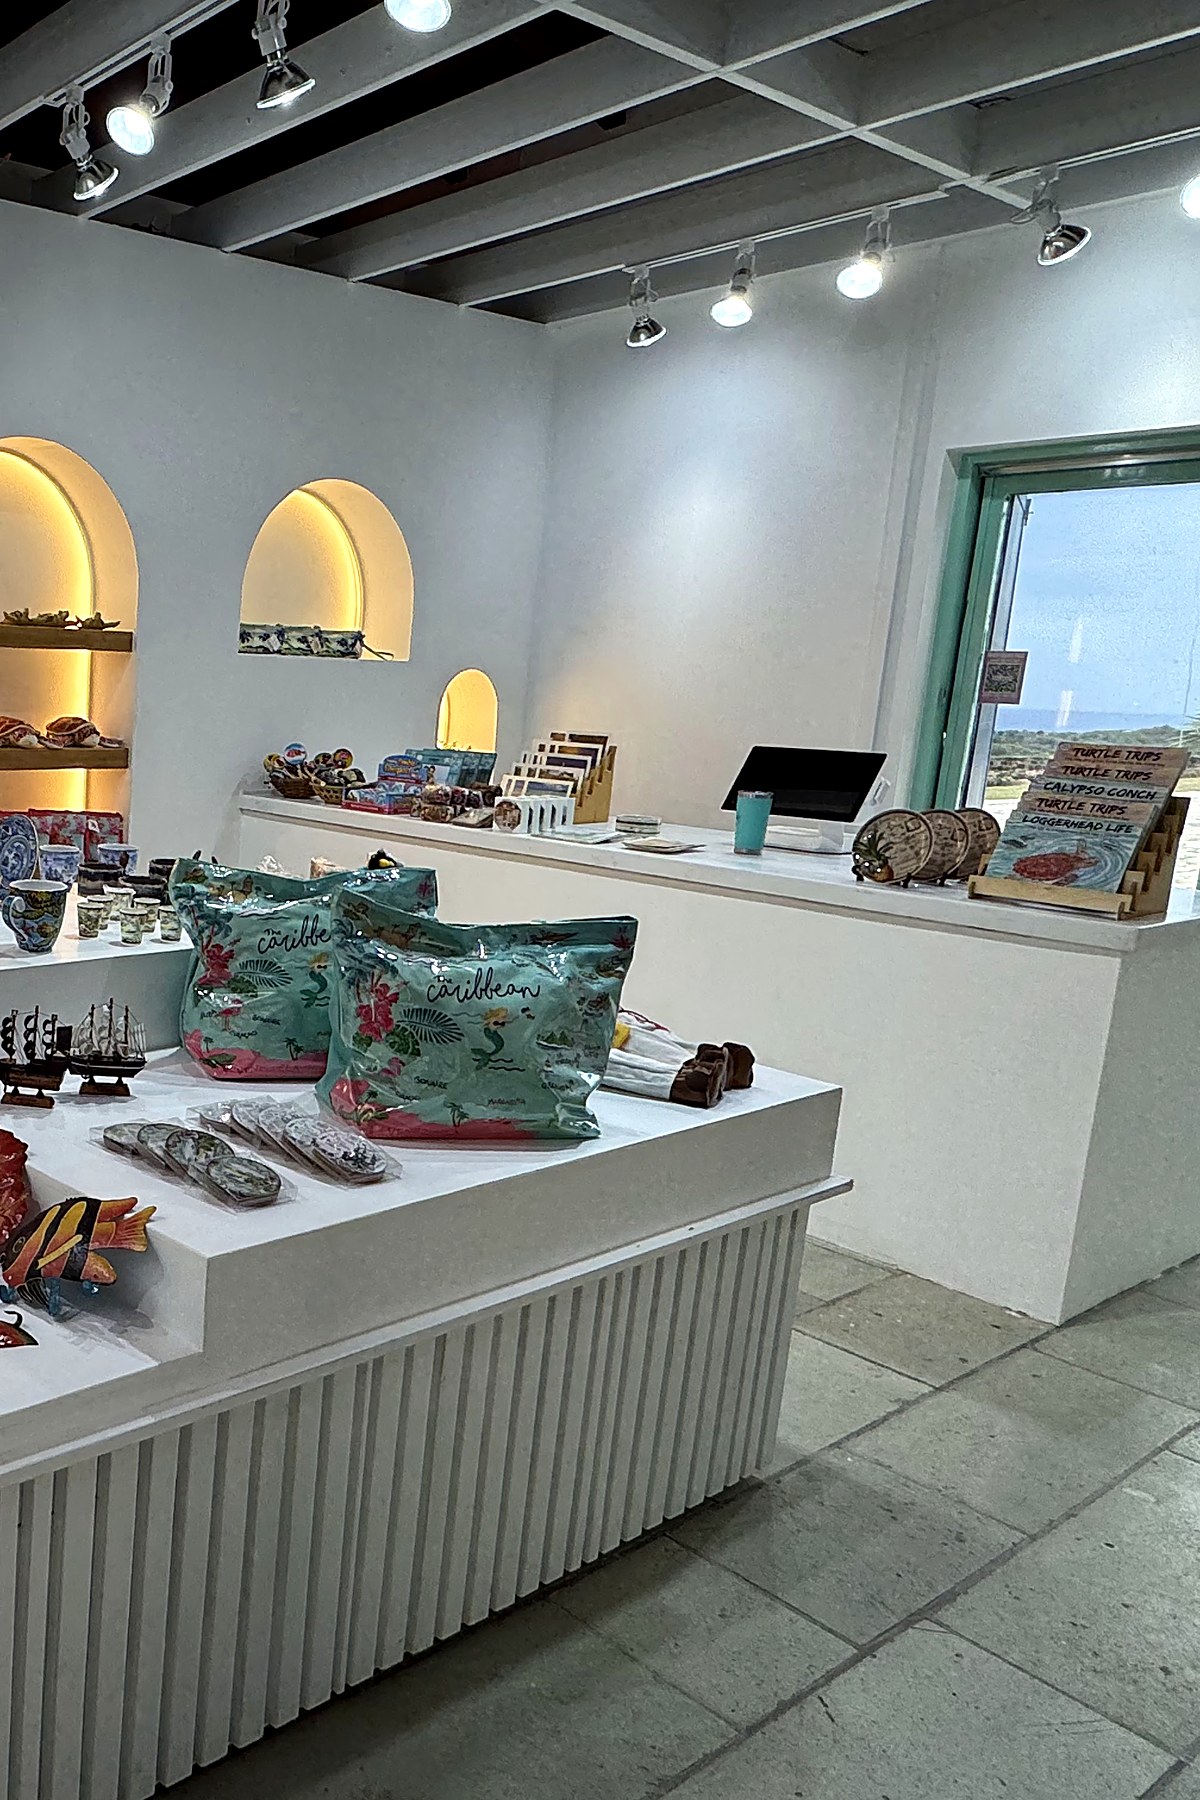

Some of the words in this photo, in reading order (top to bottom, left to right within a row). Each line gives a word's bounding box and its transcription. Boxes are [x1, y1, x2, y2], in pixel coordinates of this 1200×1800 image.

[1072, 747, 1122, 759] TURTLE
[1125, 750, 1163, 762] TRIPS
[1061, 765, 1112, 777] TURTLE
[1114, 769, 1153, 781] TRIPS
[1043, 781, 1105, 795] CALYPSO
[1107, 787, 1157, 800] CONCH
[1036, 797, 1086, 811] TURTLE
[1089, 802, 1128, 815] TRIPS
[1022, 815, 1103, 831] LOGGERHEAD
[1105, 823, 1134, 833] LIFE
[257, 913, 332, 954] caribbe
